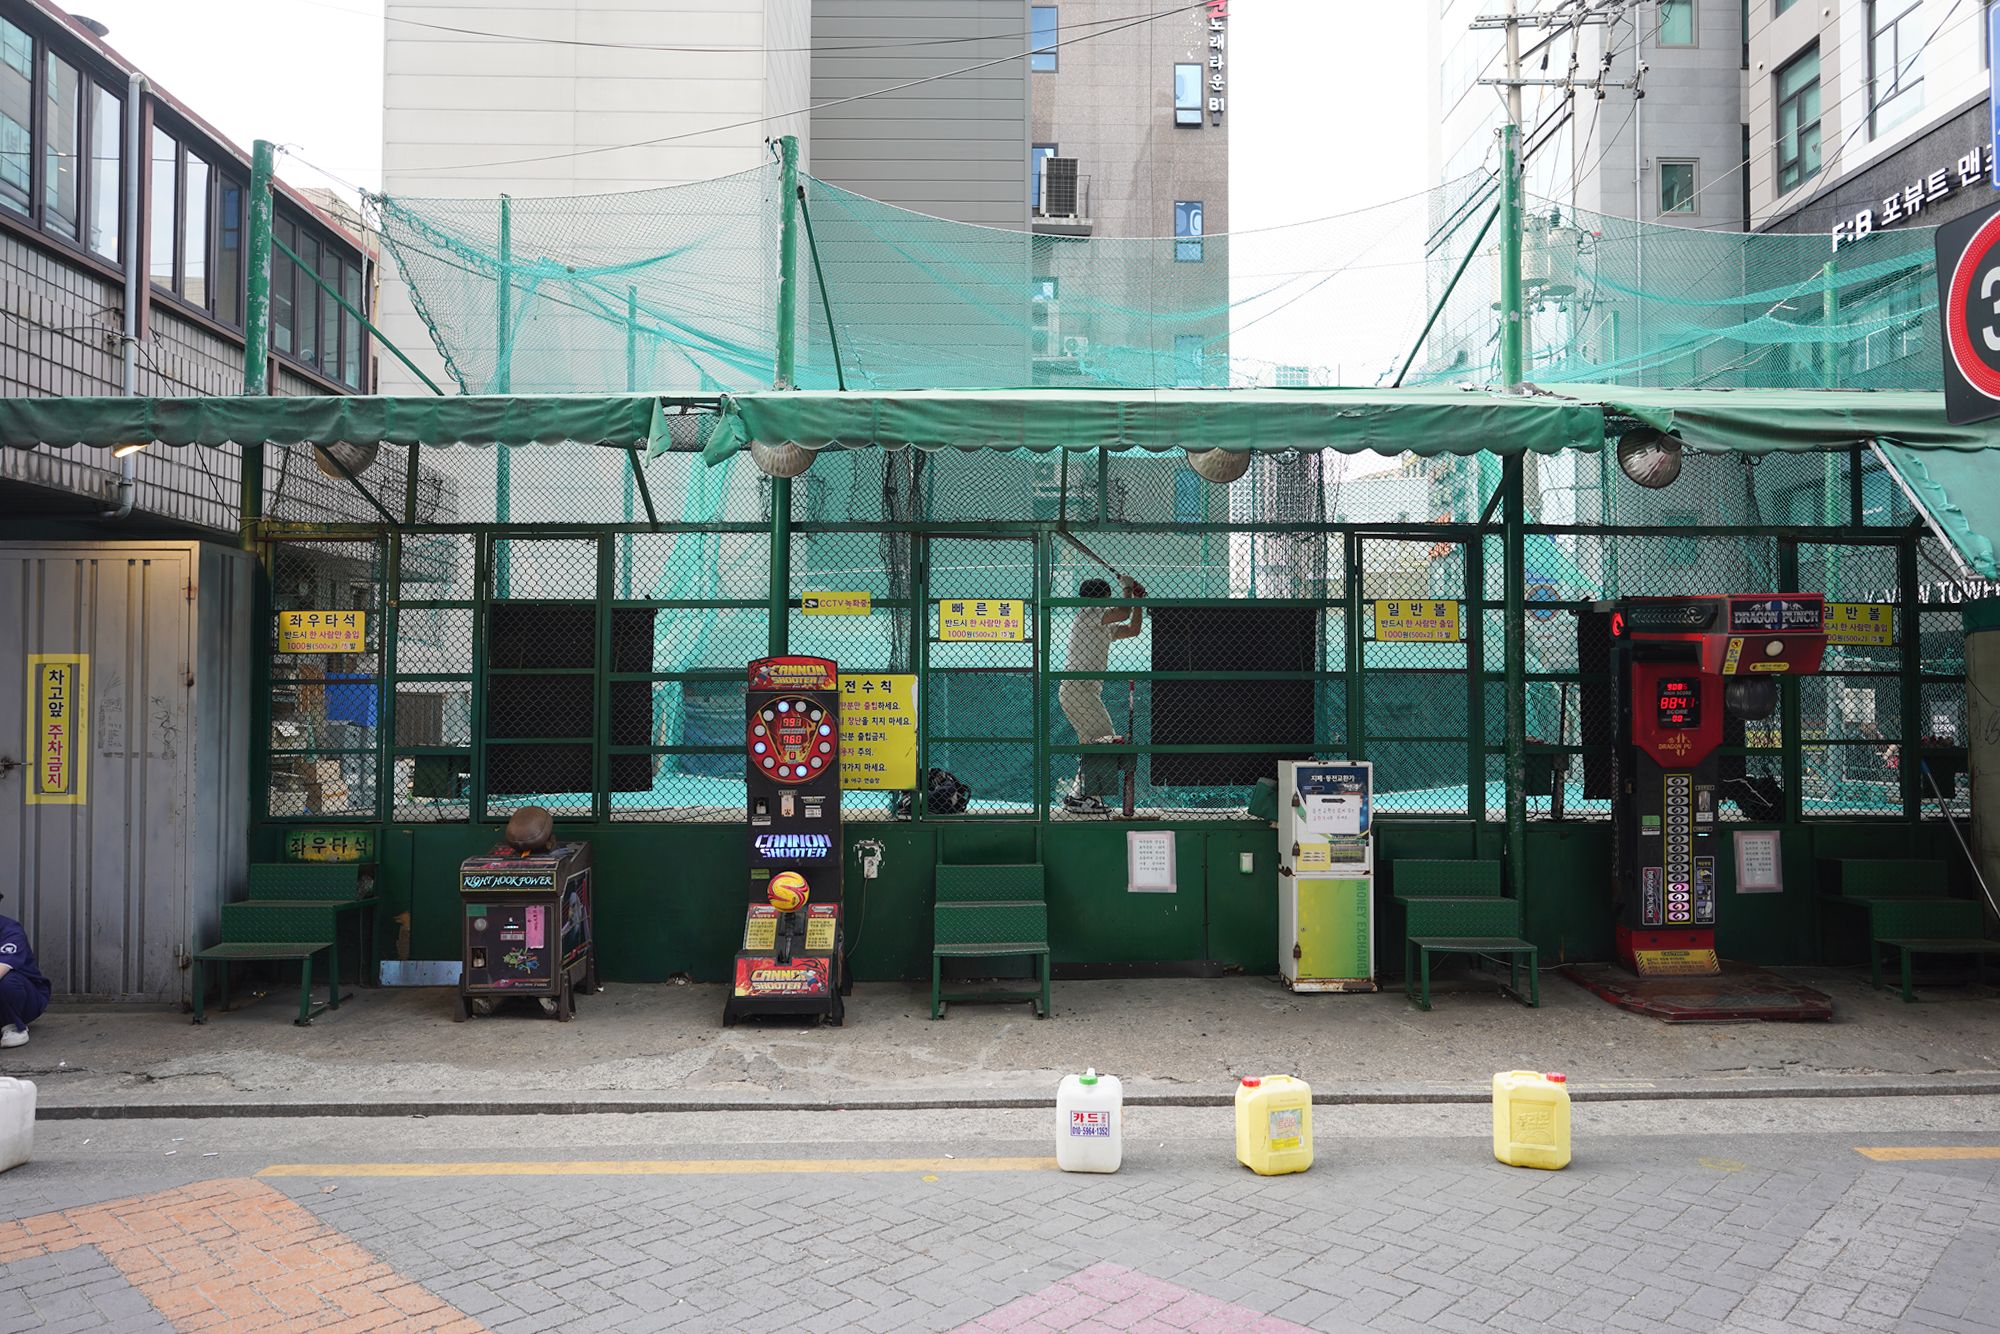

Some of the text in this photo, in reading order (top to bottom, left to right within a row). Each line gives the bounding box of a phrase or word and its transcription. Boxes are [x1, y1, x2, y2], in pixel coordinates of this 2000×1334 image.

[1208, 98, 1225, 112] B1
[1881, 168, 1949, 226] 포뷰트
[1734, 610, 1819, 624] DRAGON PUNCH
[945, 619, 1018, 628] 반드시 한 사람만 출입
[1381, 619, 1454, 628] 반드시 한 사람만 출입
[284, 630, 360, 639] 반드시 한 사람만 출입
[770, 665, 827, 676] CANNON
[47, 669, 64, 788] 차고앞 주차금지
[755, 834, 832, 848] CANNON
[760, 848, 827, 857] SHOOTER
[464, 876, 553, 888] RIGHT HOOK POWER
[1357, 882, 1367, 975] MONEY EXCHANGE
[753, 982, 801, 990] SHOOTER
[1073, 1112, 1098, 1123] 카드
